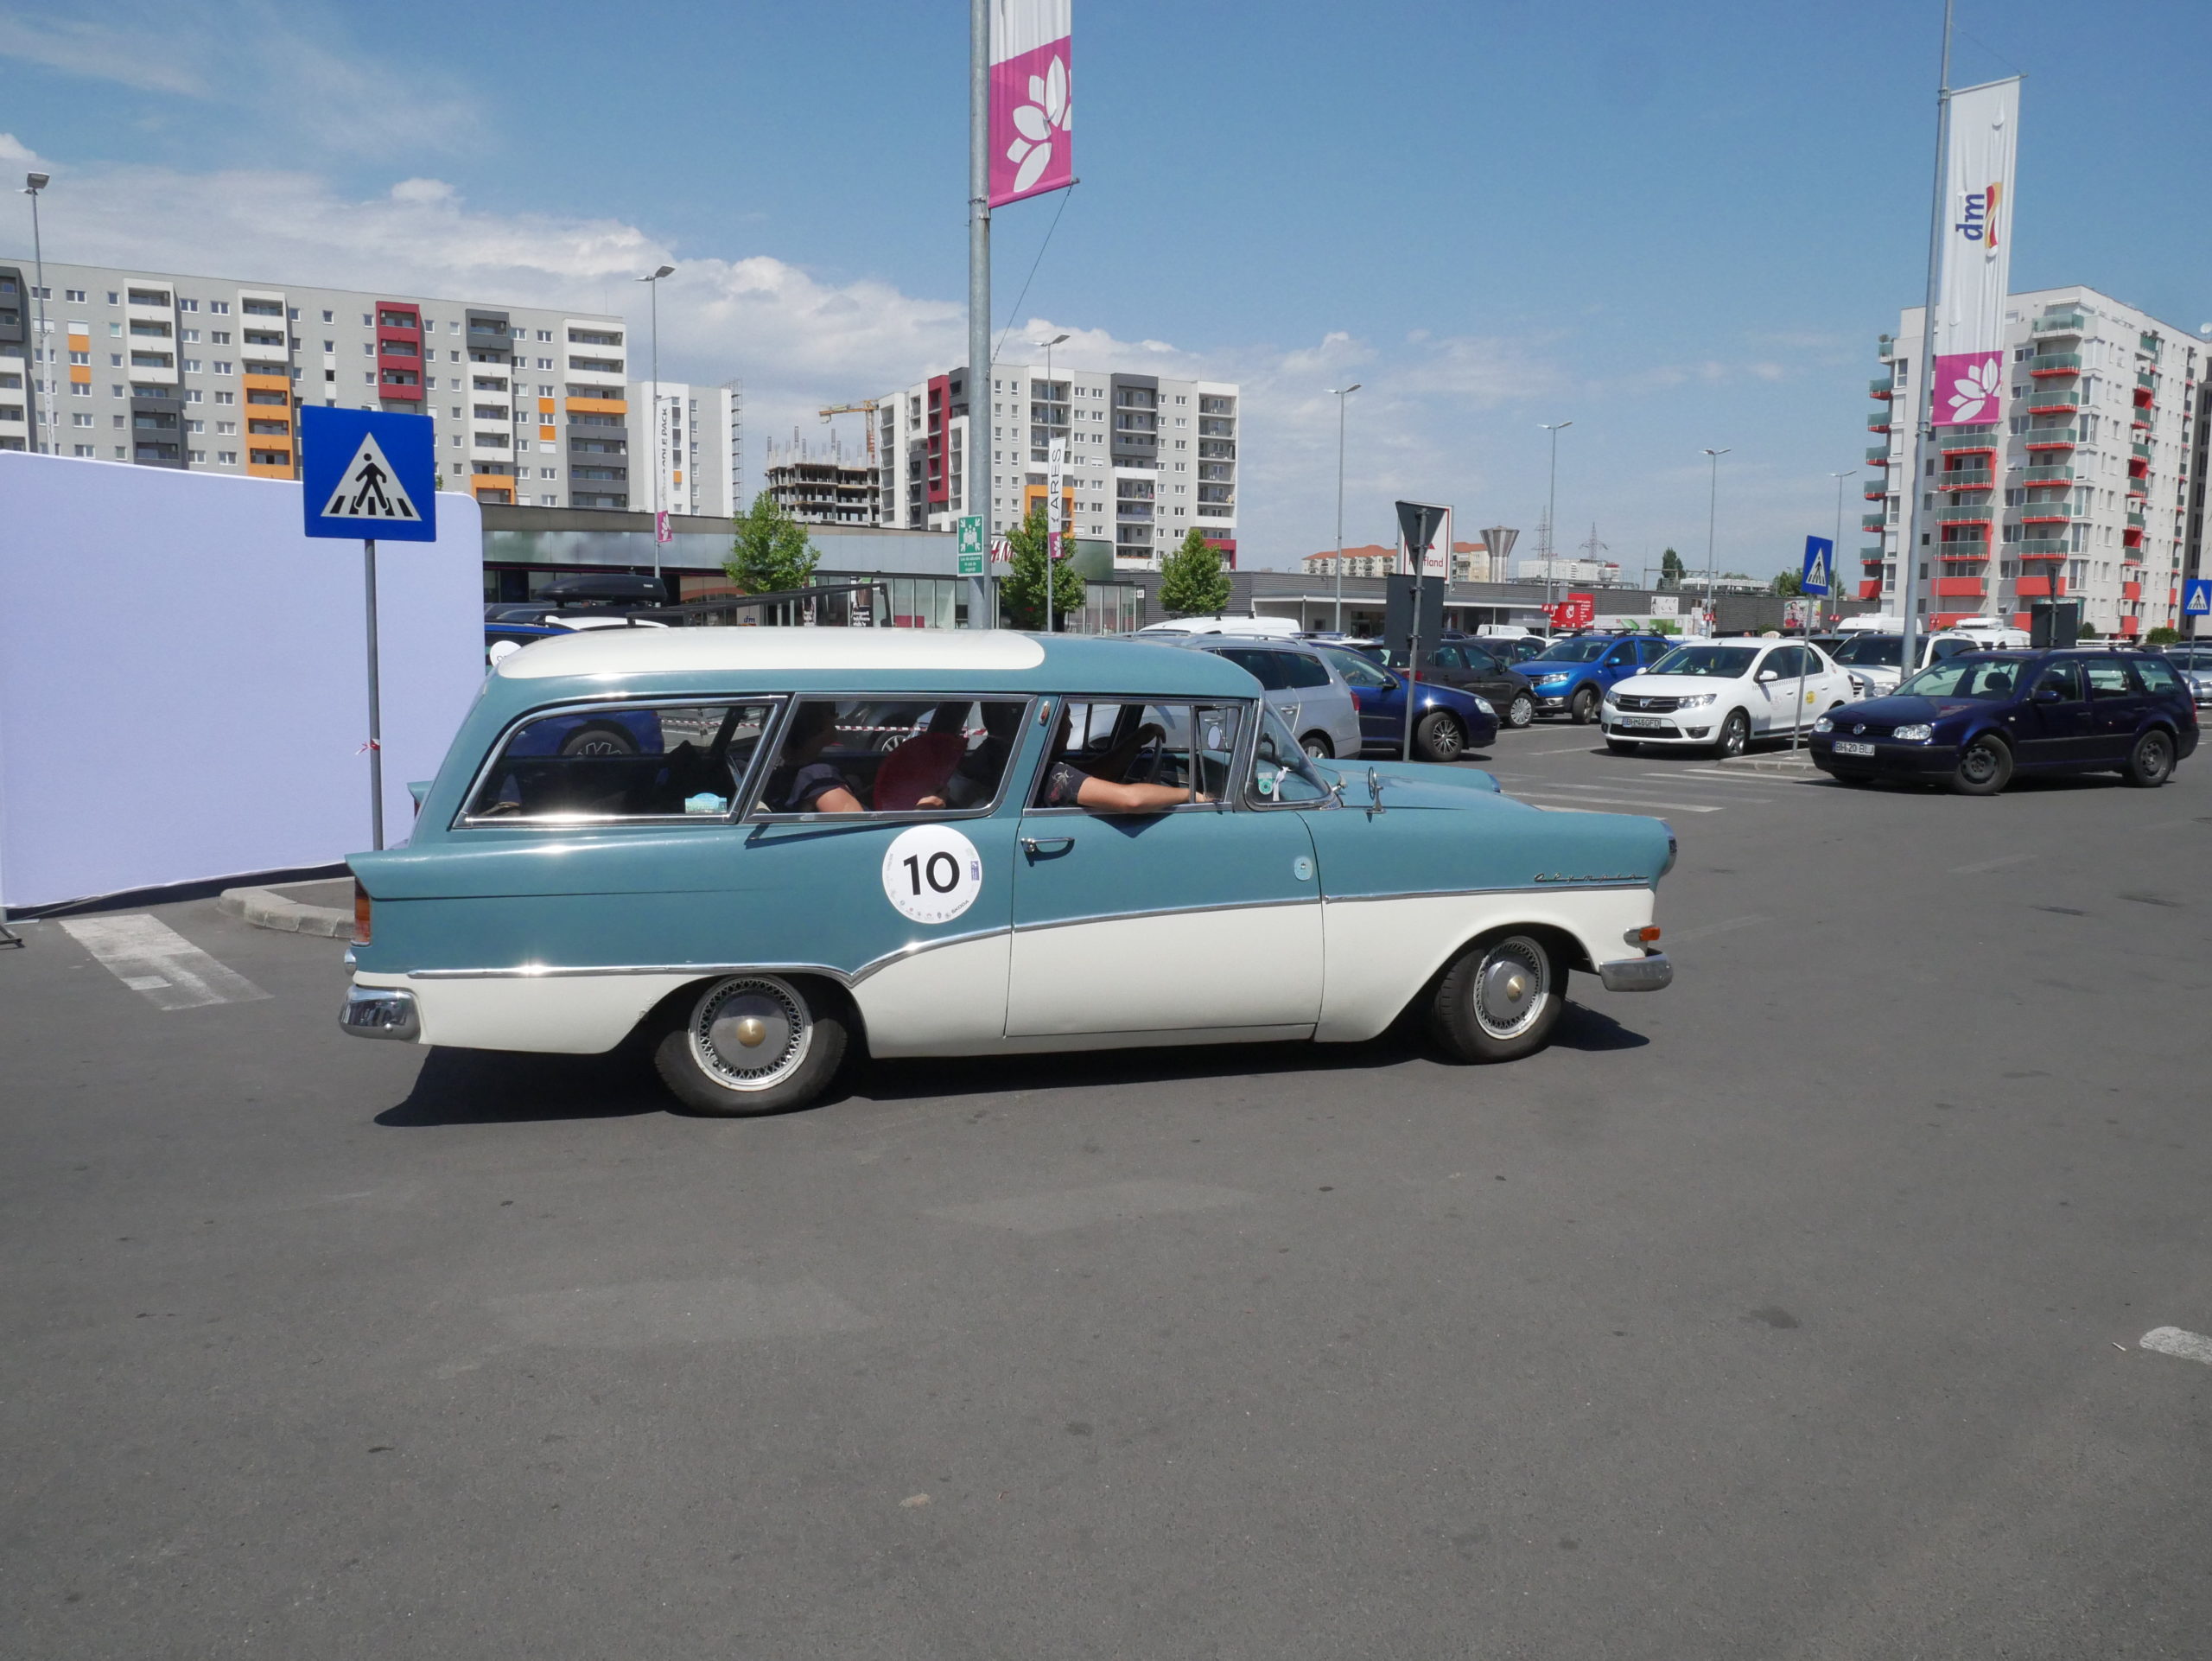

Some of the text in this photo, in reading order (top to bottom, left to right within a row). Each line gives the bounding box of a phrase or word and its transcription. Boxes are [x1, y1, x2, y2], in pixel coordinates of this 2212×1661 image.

[1955, 194, 1985, 240] dm
[1051, 449, 1062, 509] ARES
[903, 851, 960, 896] 10
